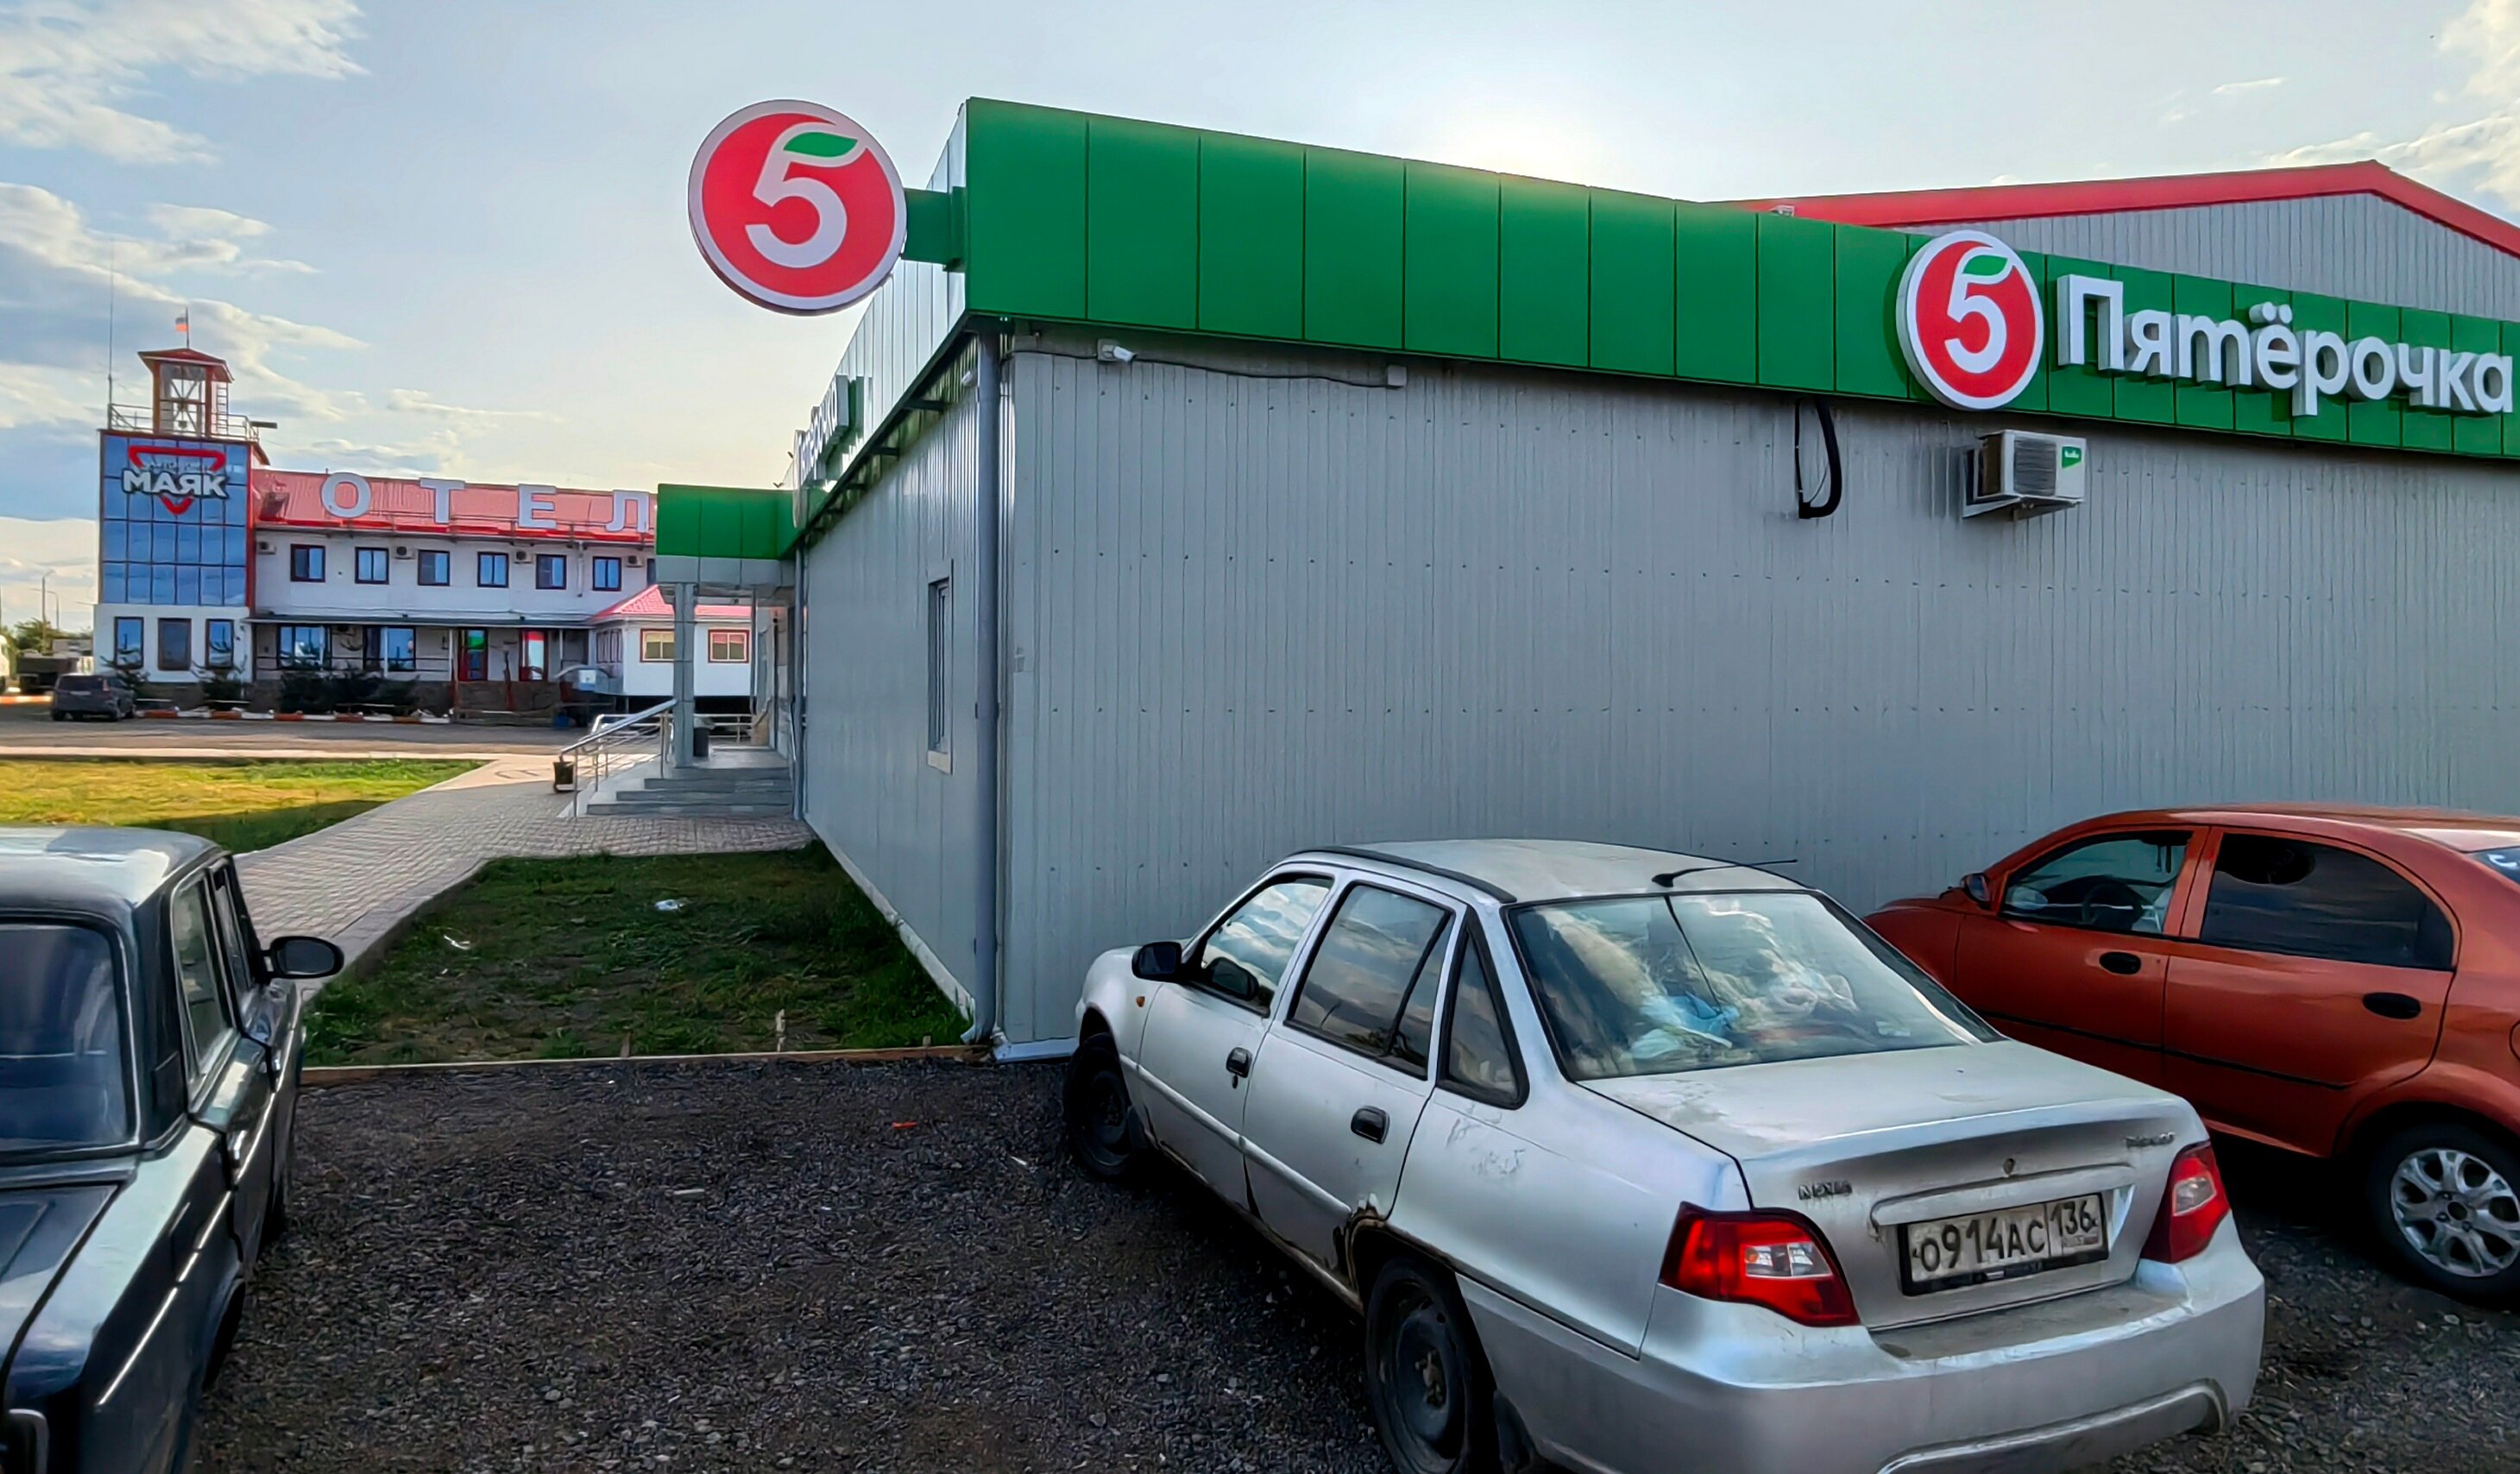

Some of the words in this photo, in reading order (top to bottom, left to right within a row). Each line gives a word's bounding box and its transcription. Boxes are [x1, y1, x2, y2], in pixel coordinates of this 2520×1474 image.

[745, 123, 865, 268] 5
[1944, 246, 2013, 374] 5
[2057, 274, 2513, 416] Пятёрочка
[123, 469, 228, 498] МАЯК
[321, 472, 650, 533] ОТЕЛ
[2050, 1200, 2095, 1237] 136
